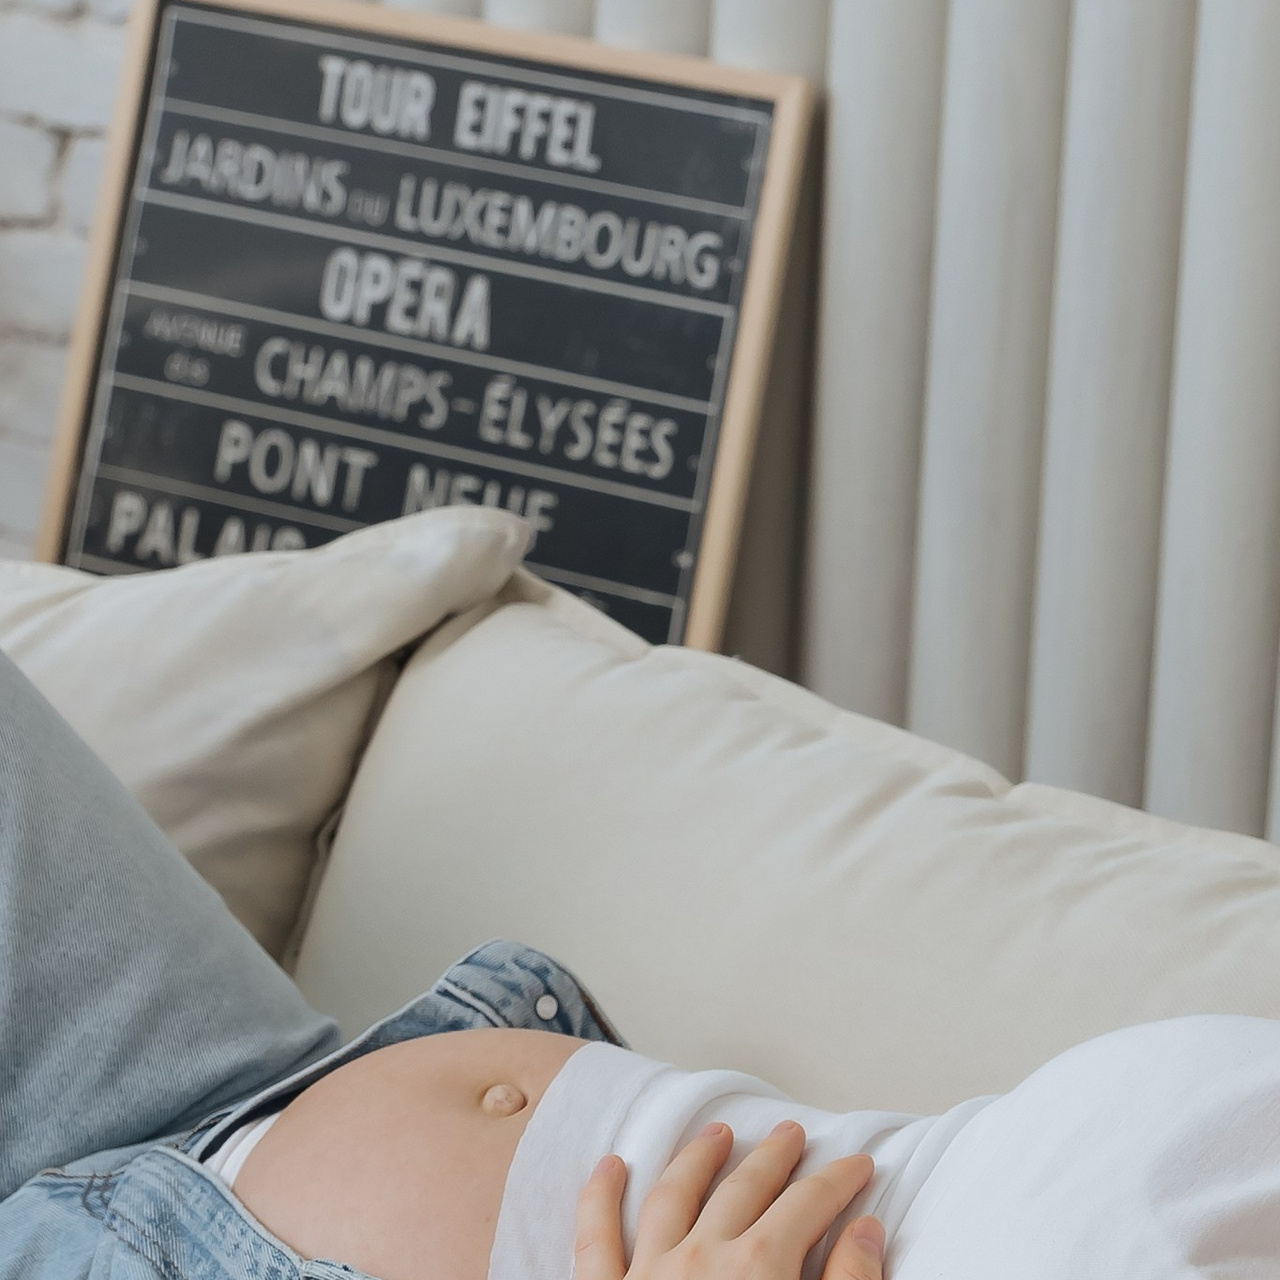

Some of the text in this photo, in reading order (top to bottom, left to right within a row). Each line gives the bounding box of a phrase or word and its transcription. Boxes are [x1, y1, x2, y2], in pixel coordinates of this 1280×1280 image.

[318, 55, 601, 173] TOUR EIFFEL
[160, 129, 349, 217] JARDINS
[395, 173, 724, 290] LUXEMBOURG
[214, 419, 378, 512] PONT
